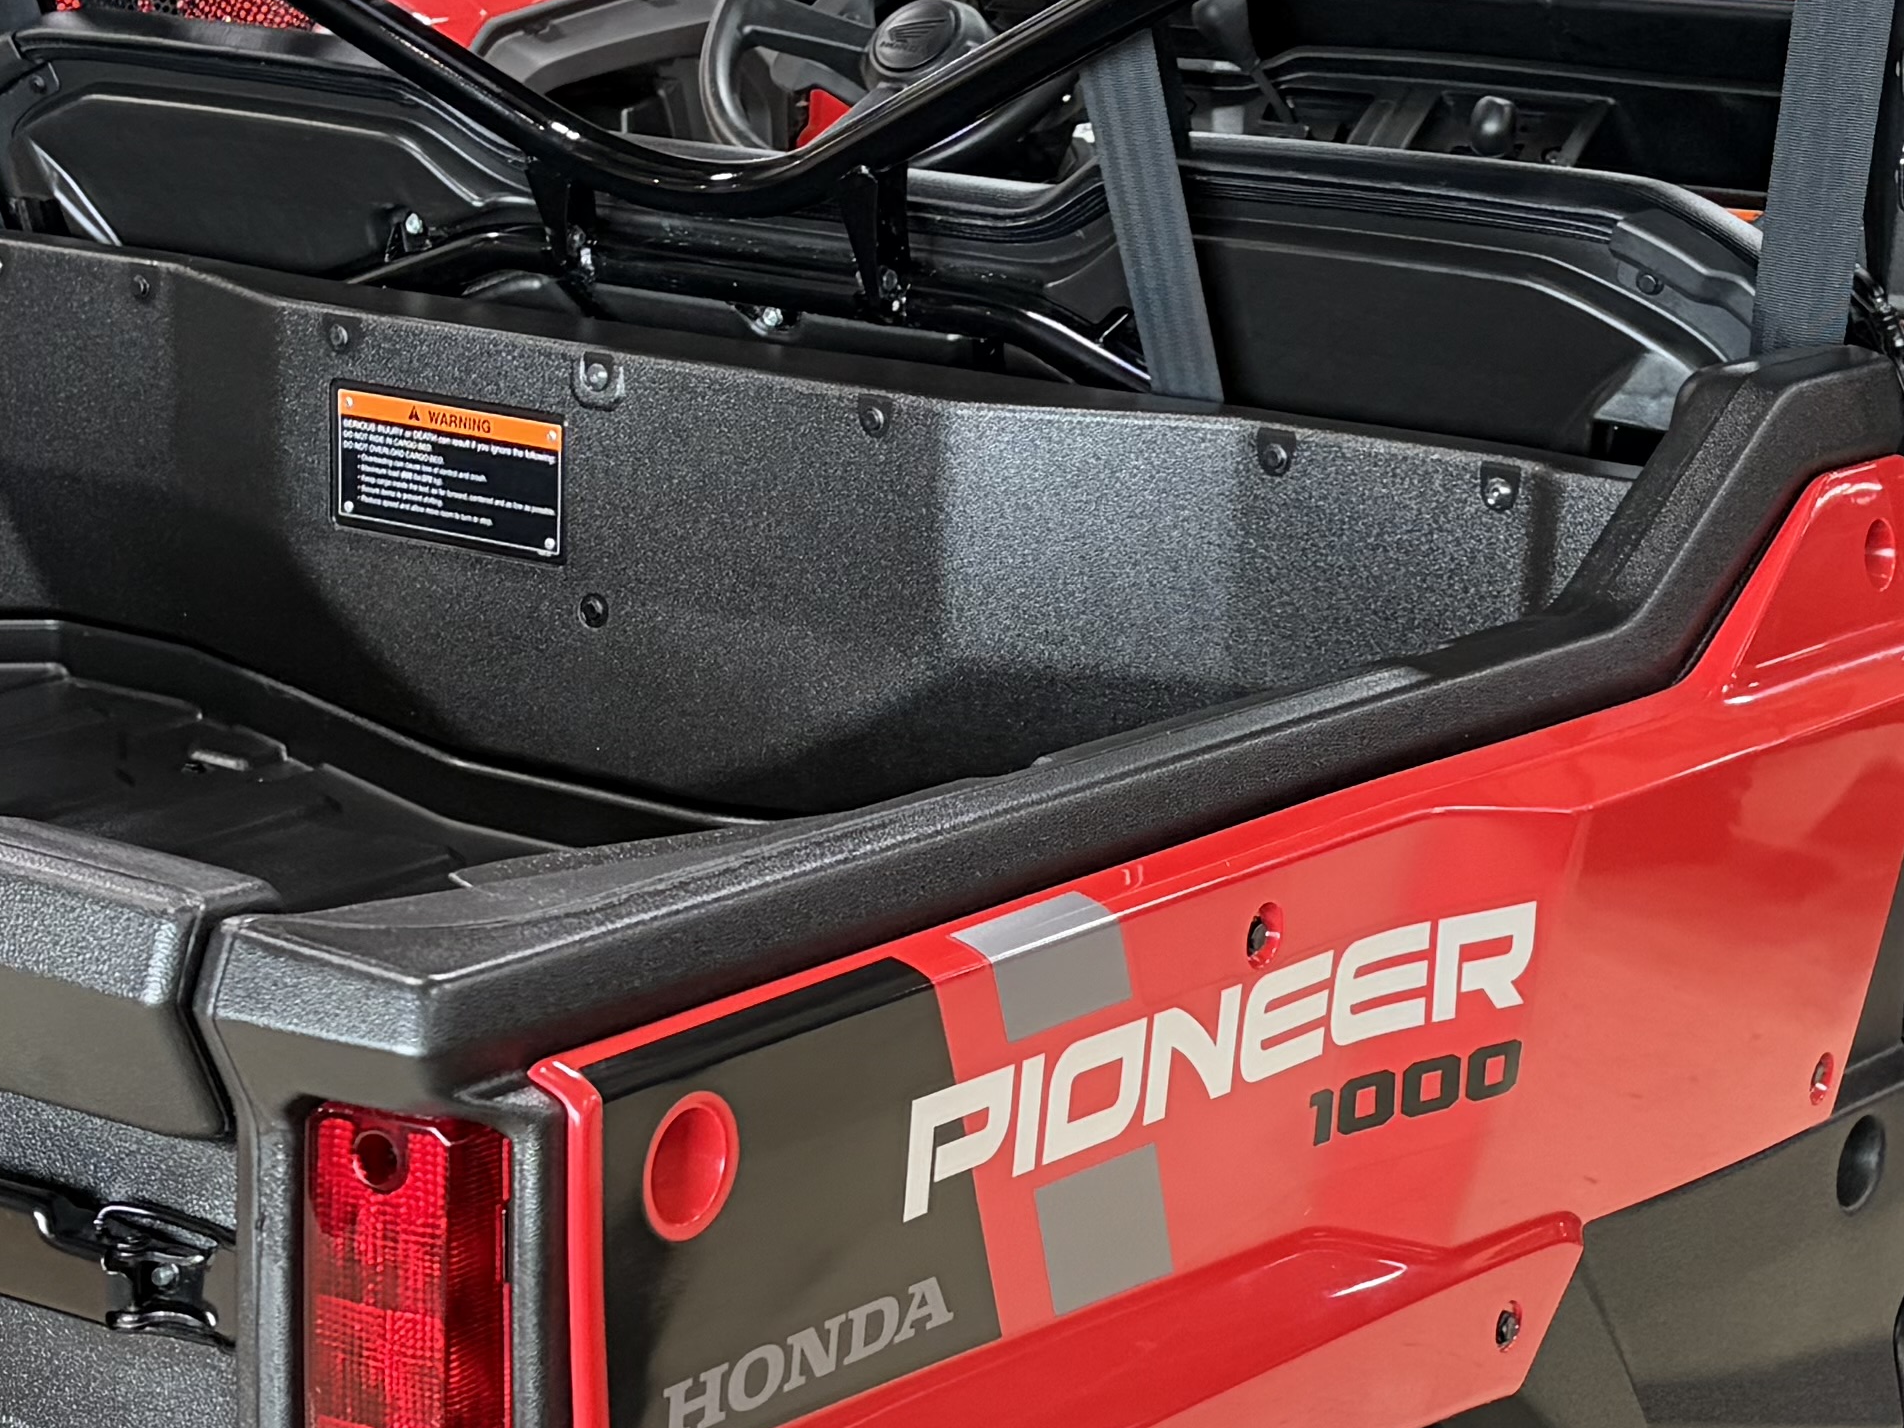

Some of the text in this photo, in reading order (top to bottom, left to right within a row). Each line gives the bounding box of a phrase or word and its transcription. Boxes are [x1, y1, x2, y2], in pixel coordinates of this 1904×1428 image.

[428, 409, 491, 434] WARNING
[902, 902, 1537, 1222] PIONEER
[1309, 1039, 1523, 1146] 1000
